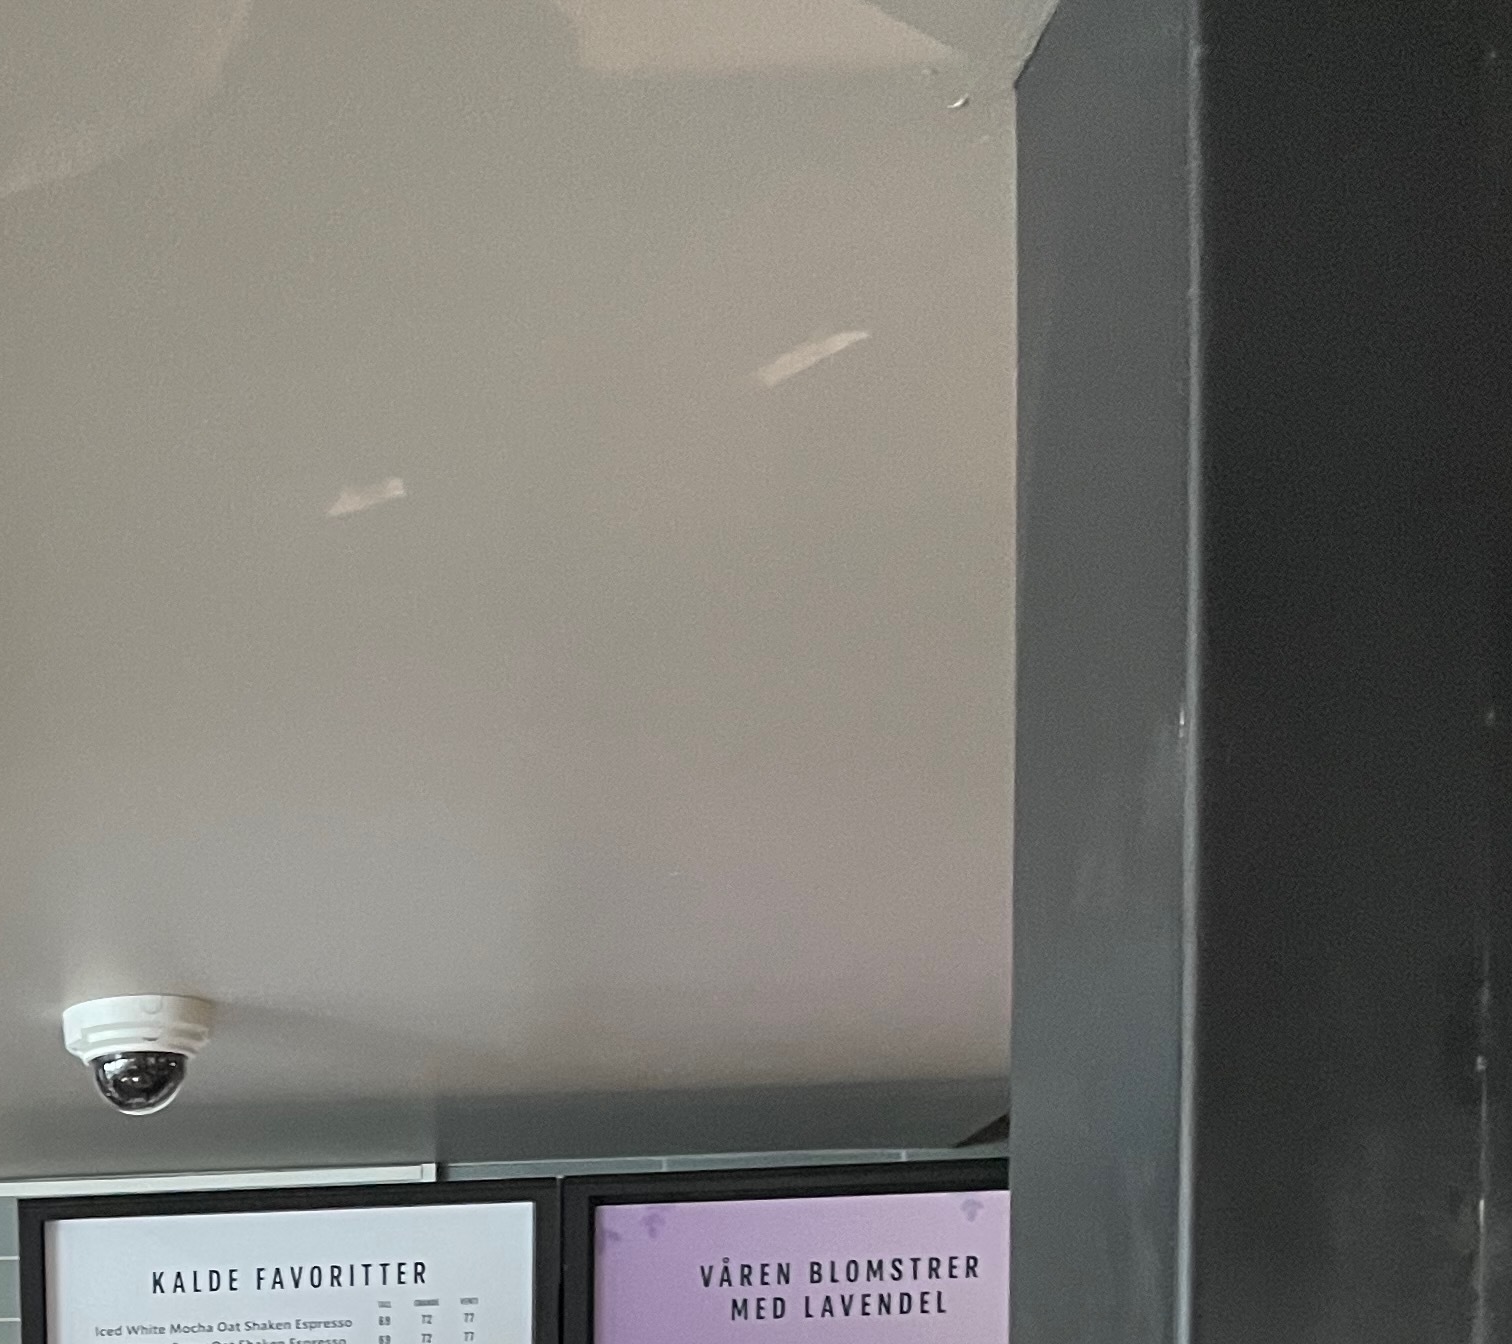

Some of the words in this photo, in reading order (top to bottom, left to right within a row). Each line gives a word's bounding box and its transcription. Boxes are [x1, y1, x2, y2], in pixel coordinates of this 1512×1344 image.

[152, 1269, 239, 1294] KALDE
[256, 1261, 427, 1290] FAVORITTER
[700, 1257, 792, 1287] VÅREN
[809, 1256, 981, 1284] BLOMSTRER
[731, 1297, 787, 1320] MED
[804, 1291, 948, 1318] LAVENDEL
[96, 1327, 122, 1336] Iced
[127, 1325, 165, 1335] White
[170, 1324, 213, 1334] Mocha
[217, 1322, 240, 1332] Oat
[245, 1320, 291, 1331] Shaken
[295, 1319, 352, 1330] Espresso
